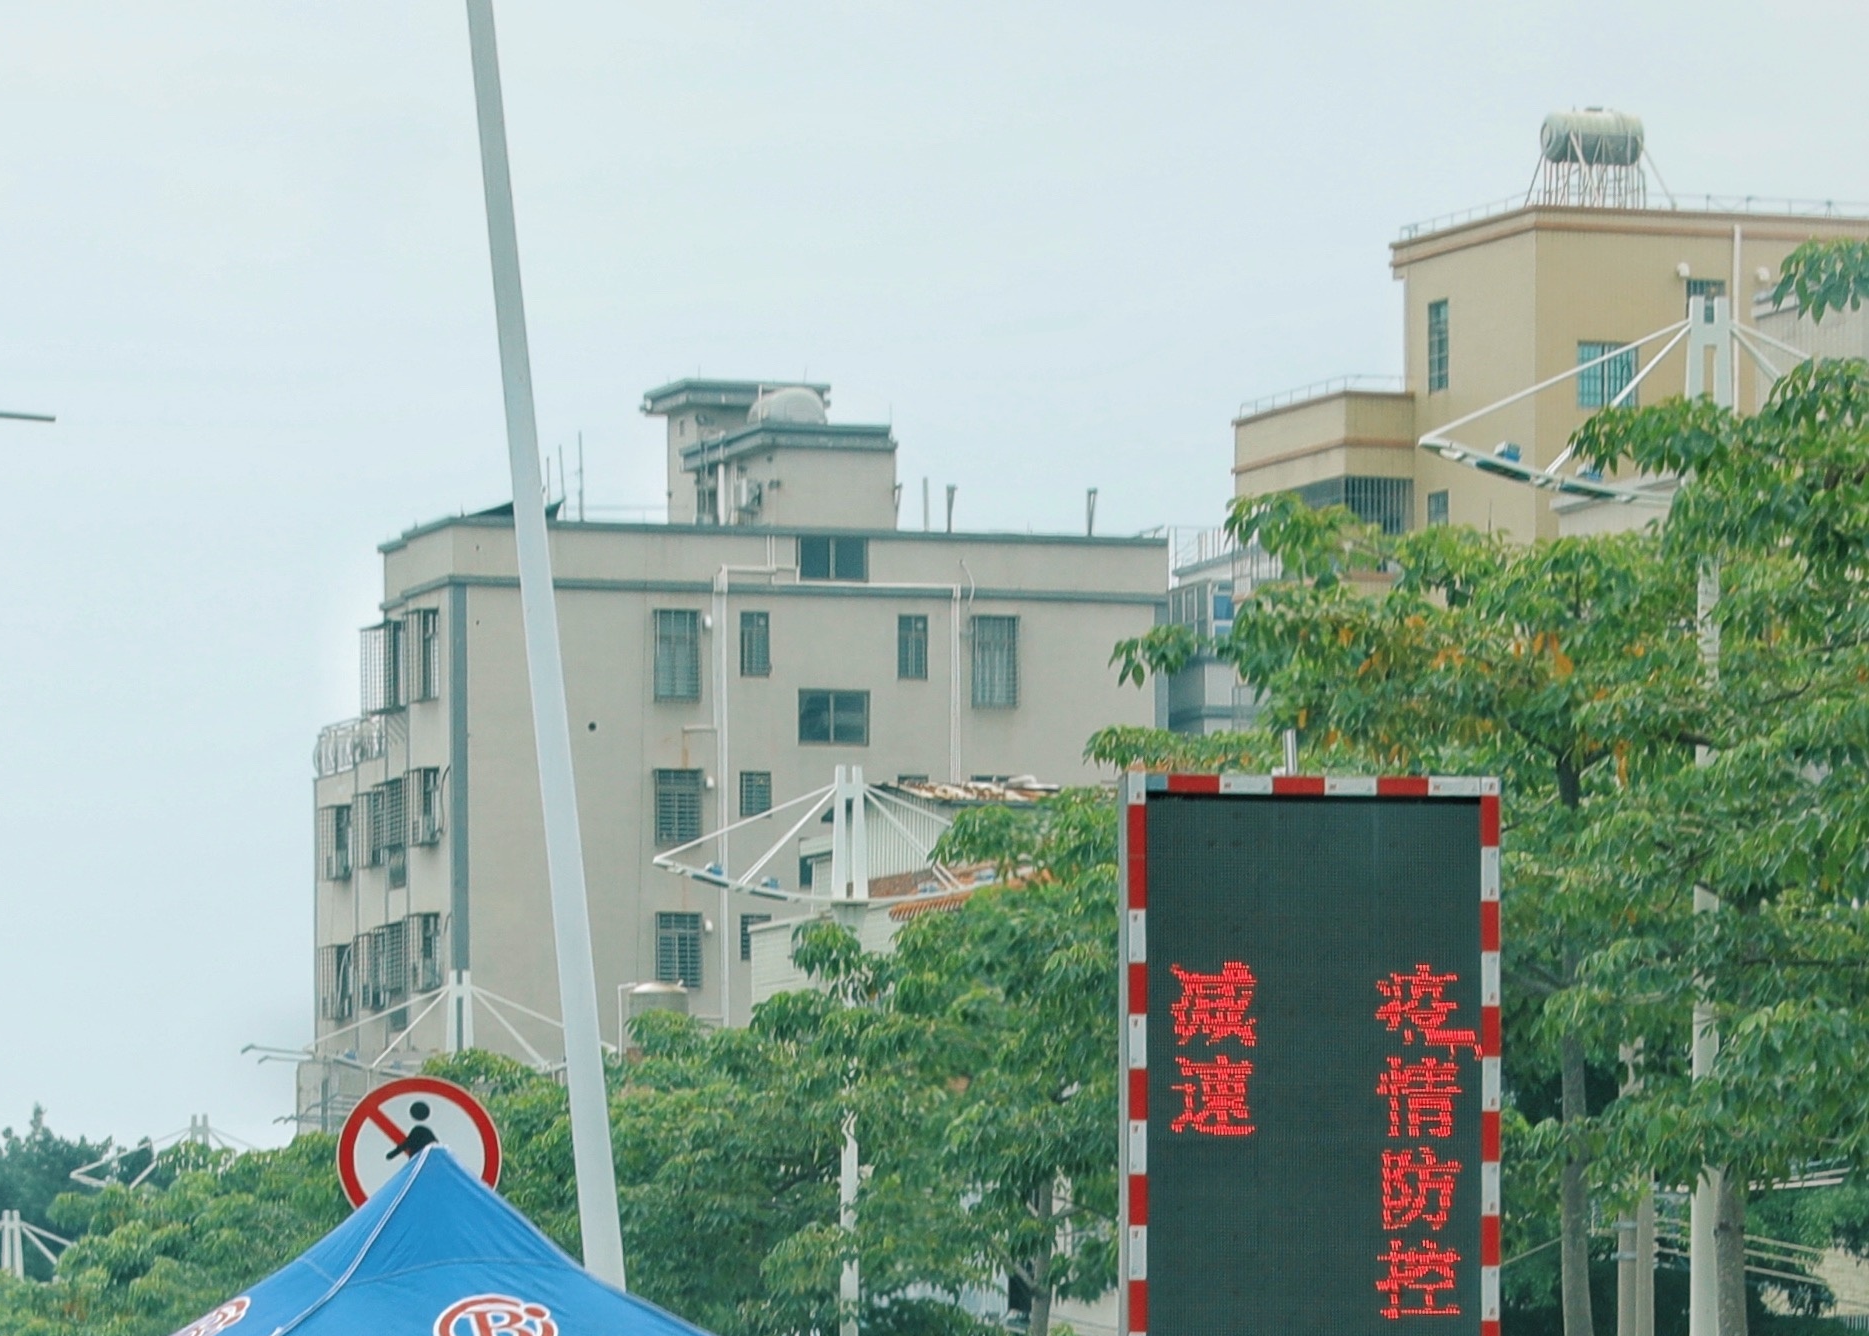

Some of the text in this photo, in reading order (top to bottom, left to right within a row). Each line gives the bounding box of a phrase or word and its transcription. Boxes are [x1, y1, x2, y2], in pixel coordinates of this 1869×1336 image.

[1170, 961, 1257, 1136] 减速
[1376, 963, 1470, 1319] 疫情防控
